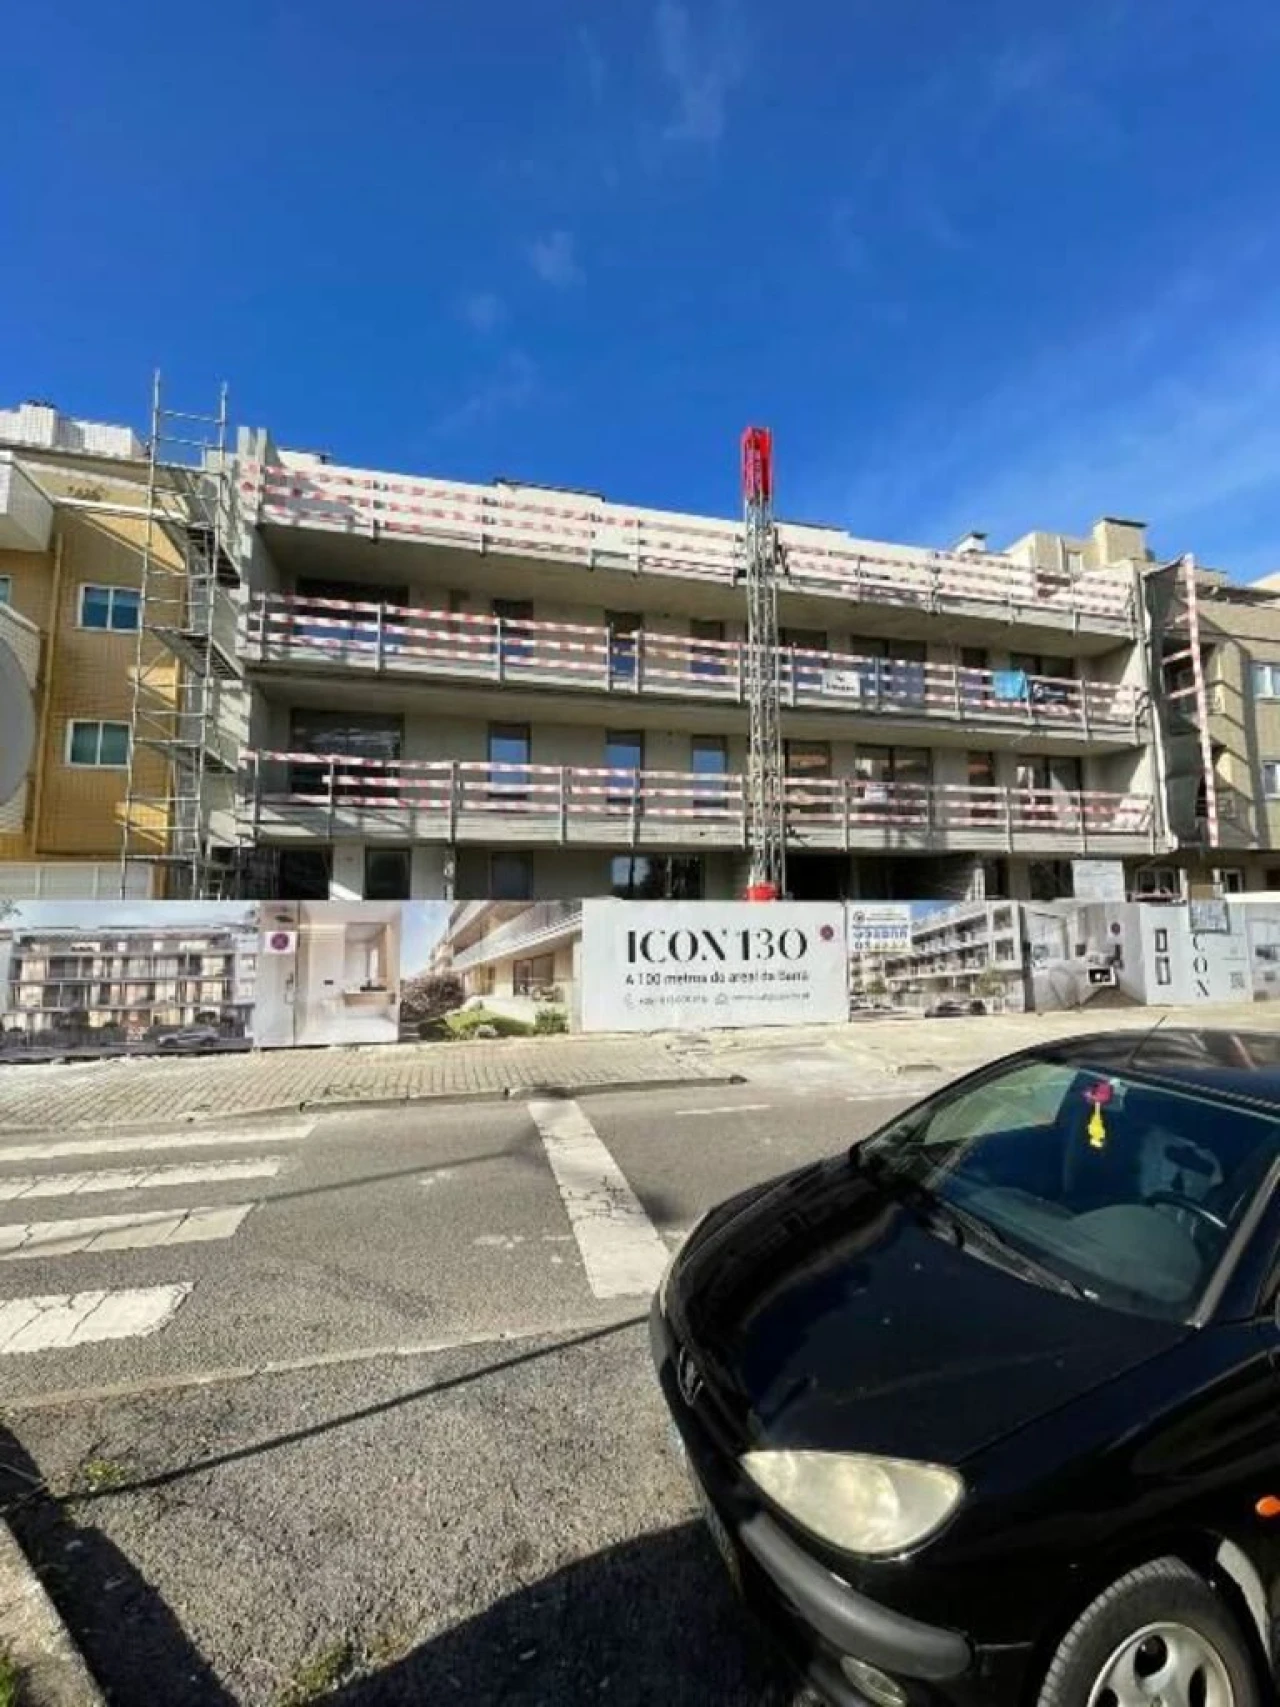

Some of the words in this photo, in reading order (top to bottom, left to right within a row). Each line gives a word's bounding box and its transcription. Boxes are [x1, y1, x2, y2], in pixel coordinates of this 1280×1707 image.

[627, 928, 727, 963] ICON
[737, 927, 808, 961] 130
[626, 973, 635, 985] A
[639, 973, 661, 985] 100
[1193, 932, 1210, 998] CON
